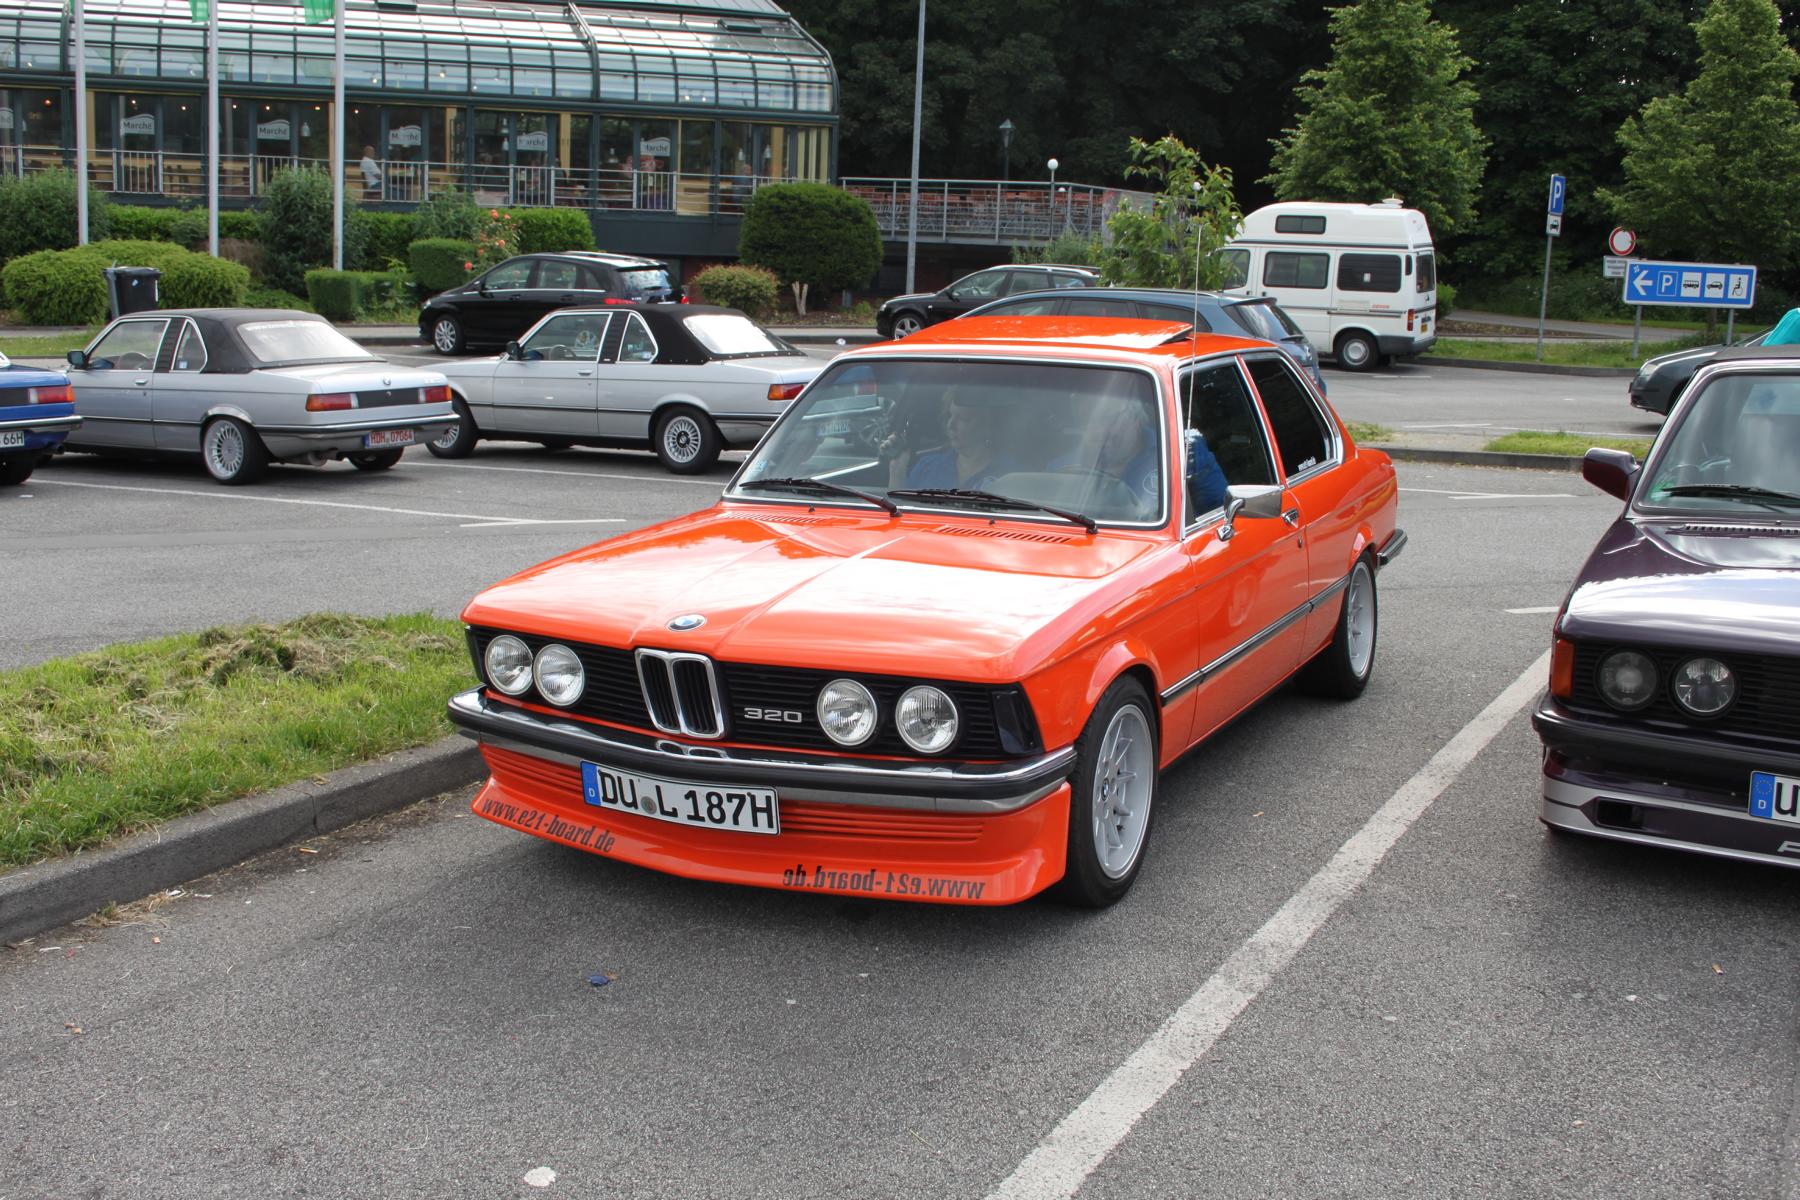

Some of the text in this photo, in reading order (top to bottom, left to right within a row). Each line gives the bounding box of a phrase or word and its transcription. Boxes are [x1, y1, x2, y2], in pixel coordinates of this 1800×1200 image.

[1553, 180, 1562, 208] P
[1661, 274, 1673, 293] P
[3, 431, 23, 445] 66H
[744, 707, 802, 723] 320
[589, 788, 596, 798] D
[599, 768, 775, 829] DU L 187H
[1775, 782, 1800, 817] U
[481, 798, 616, 853] www.e21-board.de
